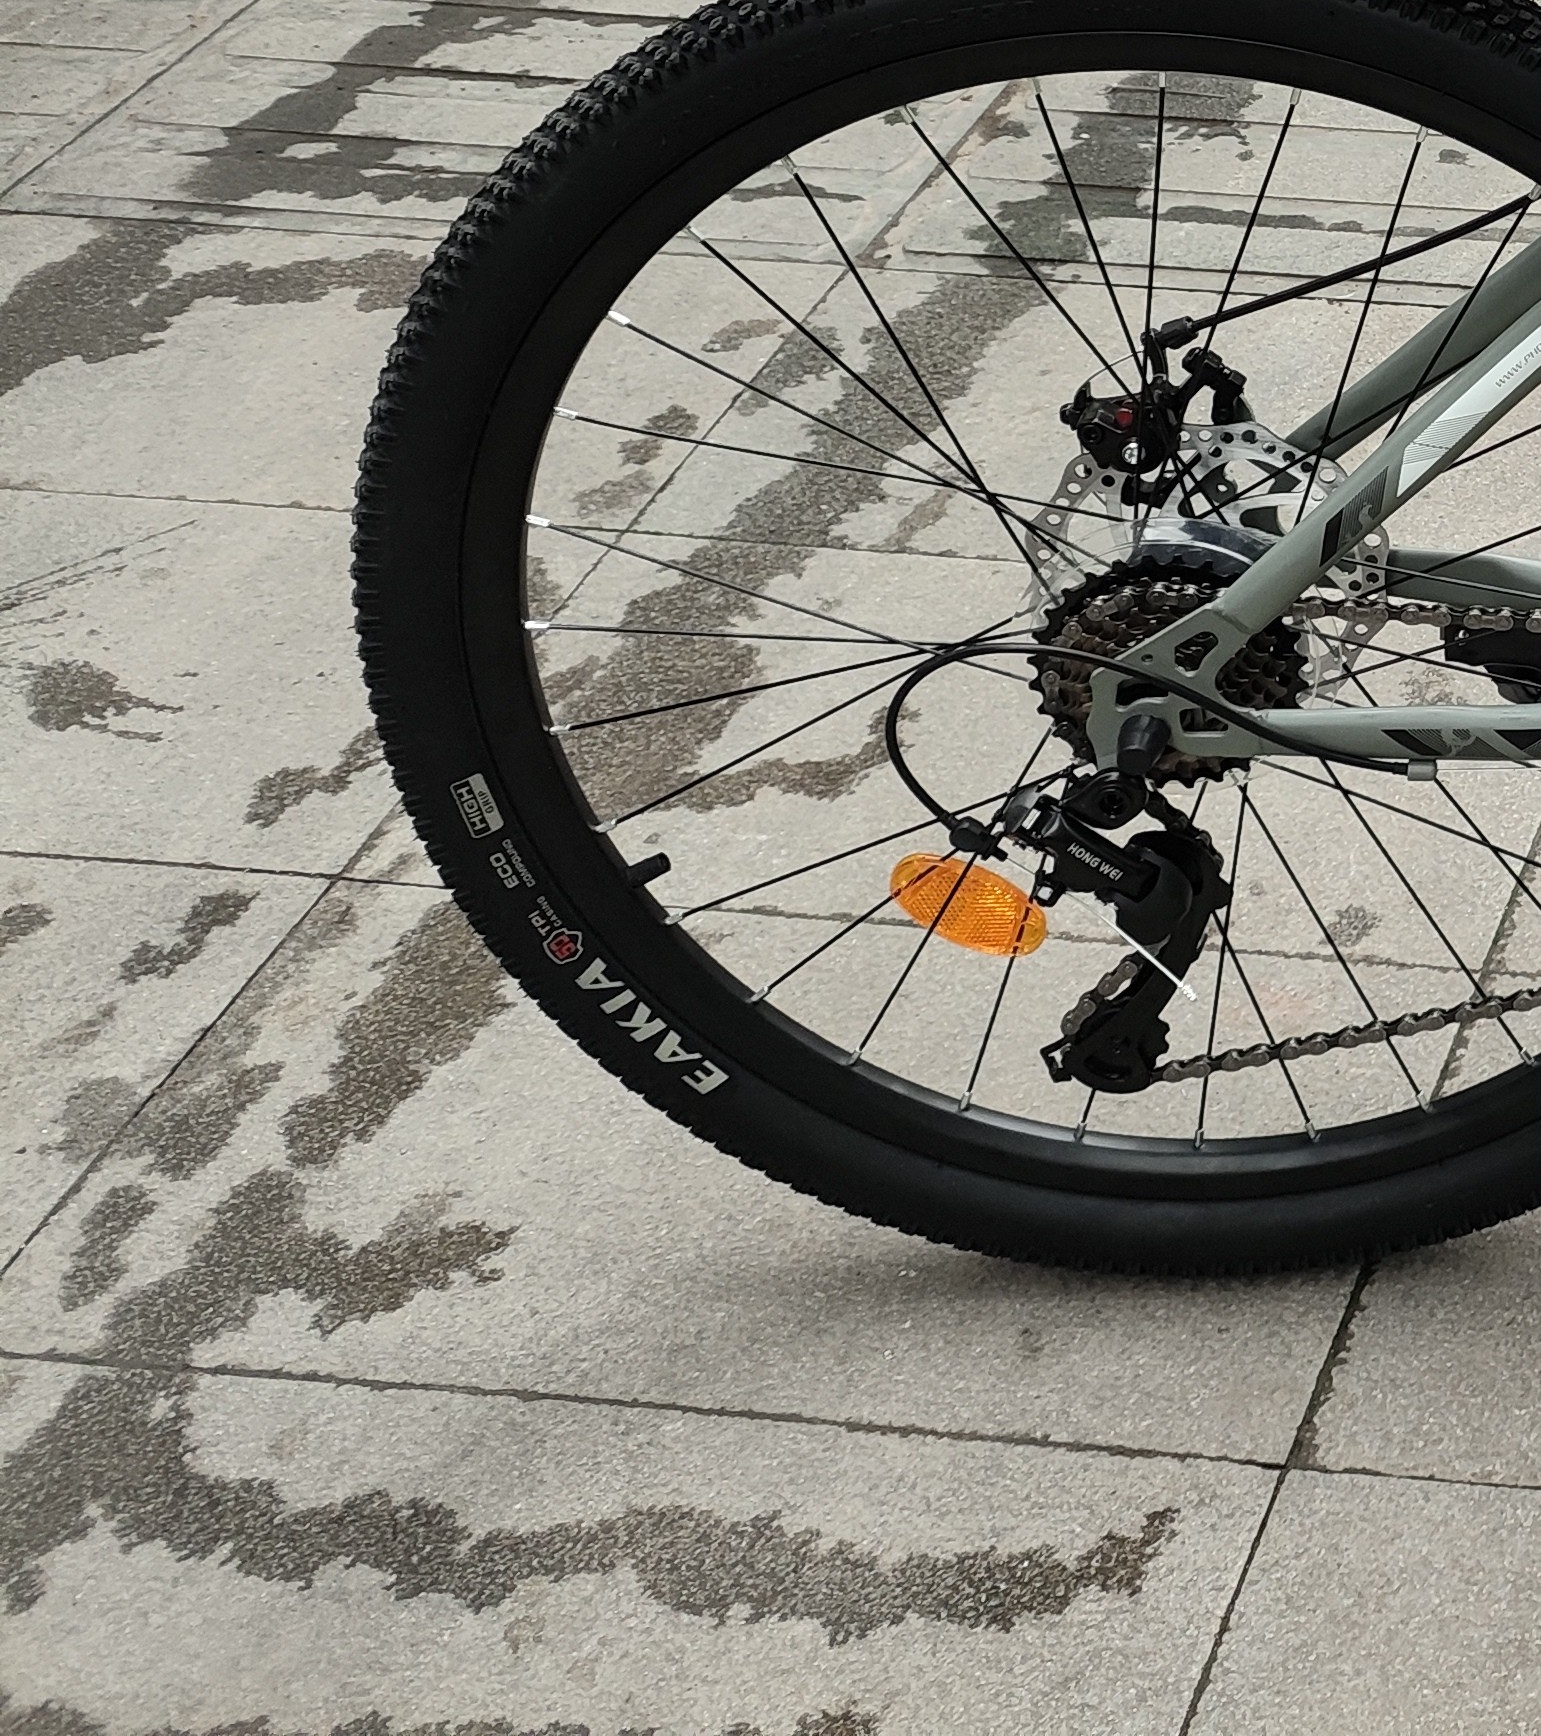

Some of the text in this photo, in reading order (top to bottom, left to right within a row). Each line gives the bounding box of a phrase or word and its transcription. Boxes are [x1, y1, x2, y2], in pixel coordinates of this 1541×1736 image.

[456, 785, 487, 831] HIGH
[477, 790, 495, 814] GRIP
[489, 852, 520, 889] ECO
[502, 838, 536, 888] COMPOUND
[1067, 842, 1124, 882] HONG WEI
[528, 910, 552, 937] TPI
[536, 895, 563, 928] CASING
[574, 957, 730, 1095] EAKIA
